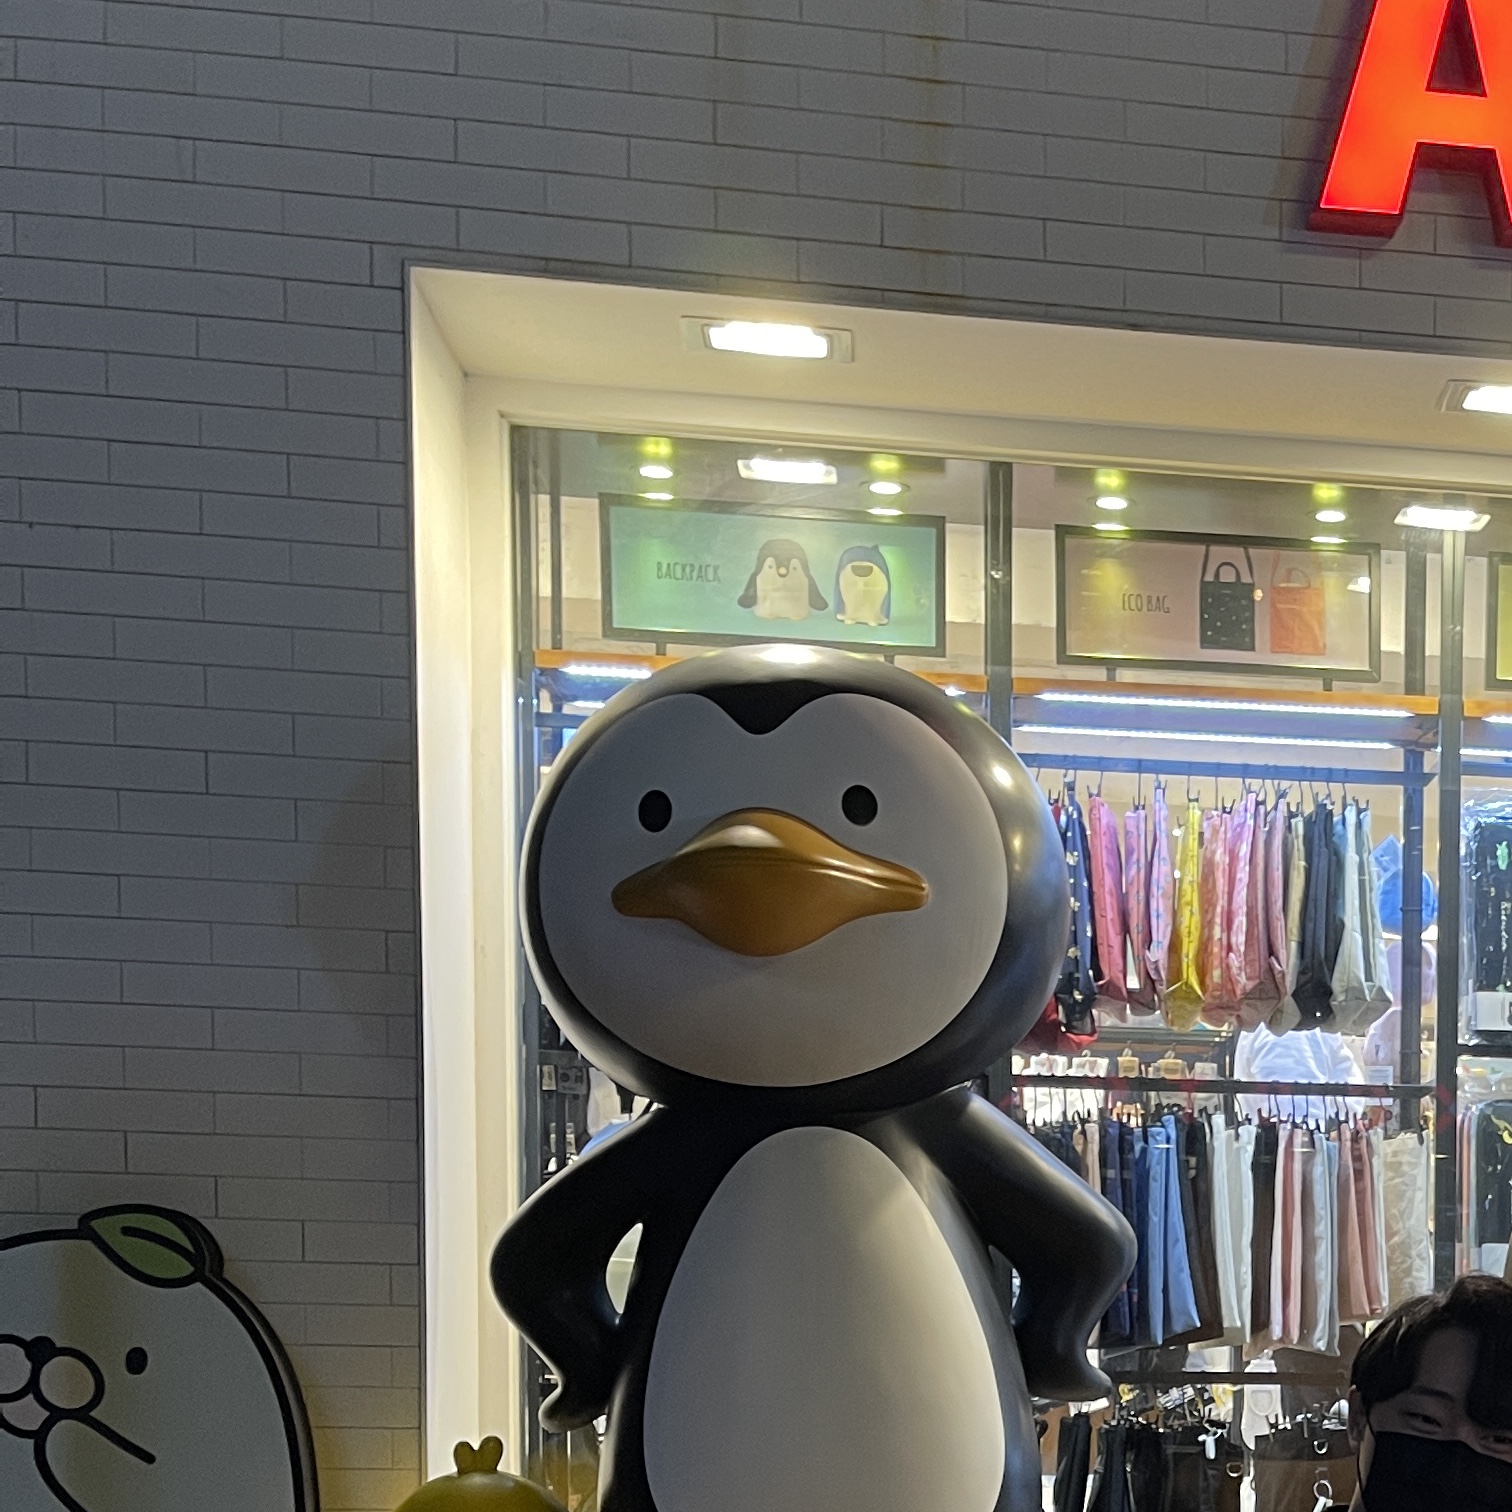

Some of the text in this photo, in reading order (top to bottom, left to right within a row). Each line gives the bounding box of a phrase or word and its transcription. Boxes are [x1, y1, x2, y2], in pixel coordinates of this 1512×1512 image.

[655, 560, 722, 583] BACKPACK
[1121, 592, 1171, 614] ECO BAG
